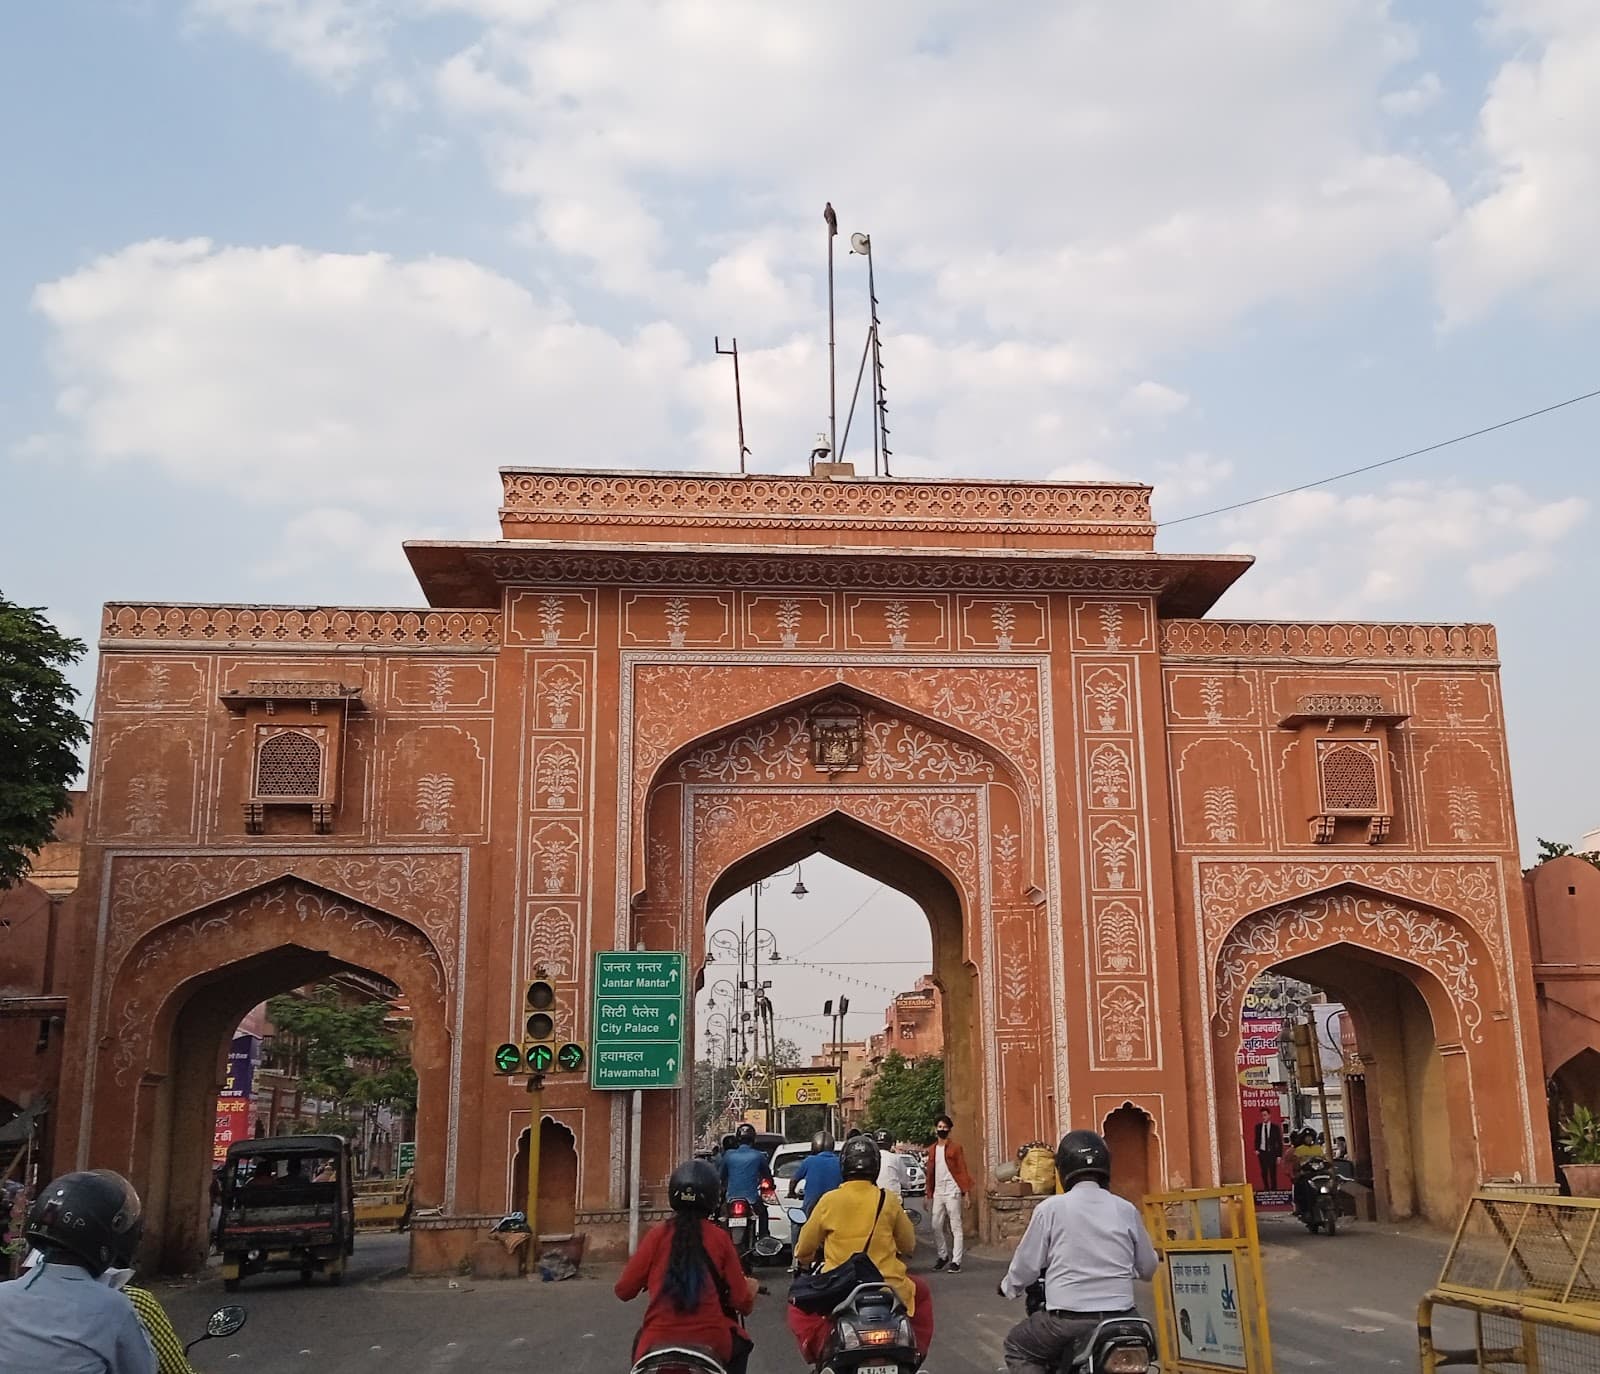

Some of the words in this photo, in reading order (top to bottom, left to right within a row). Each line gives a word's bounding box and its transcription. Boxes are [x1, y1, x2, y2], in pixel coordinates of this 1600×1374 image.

[602, 962, 631, 973] जन्तर
[635, 962, 662, 973] मन्तर
[602, 978, 634, 988] Jantar
[636, 978, 670, 988] Mantar
[601, 1004, 627, 1018] सिटी
[632, 1004, 660, 1018] पैलेस
[600, 1023, 622, 1036] City
[624, 1023, 660, 1033] Palace
[600, 1051, 644, 1063] हवामहल
[599, 1067, 660, 1078] Hawamahal
[1242, 1090, 1259, 1098] Ravi
